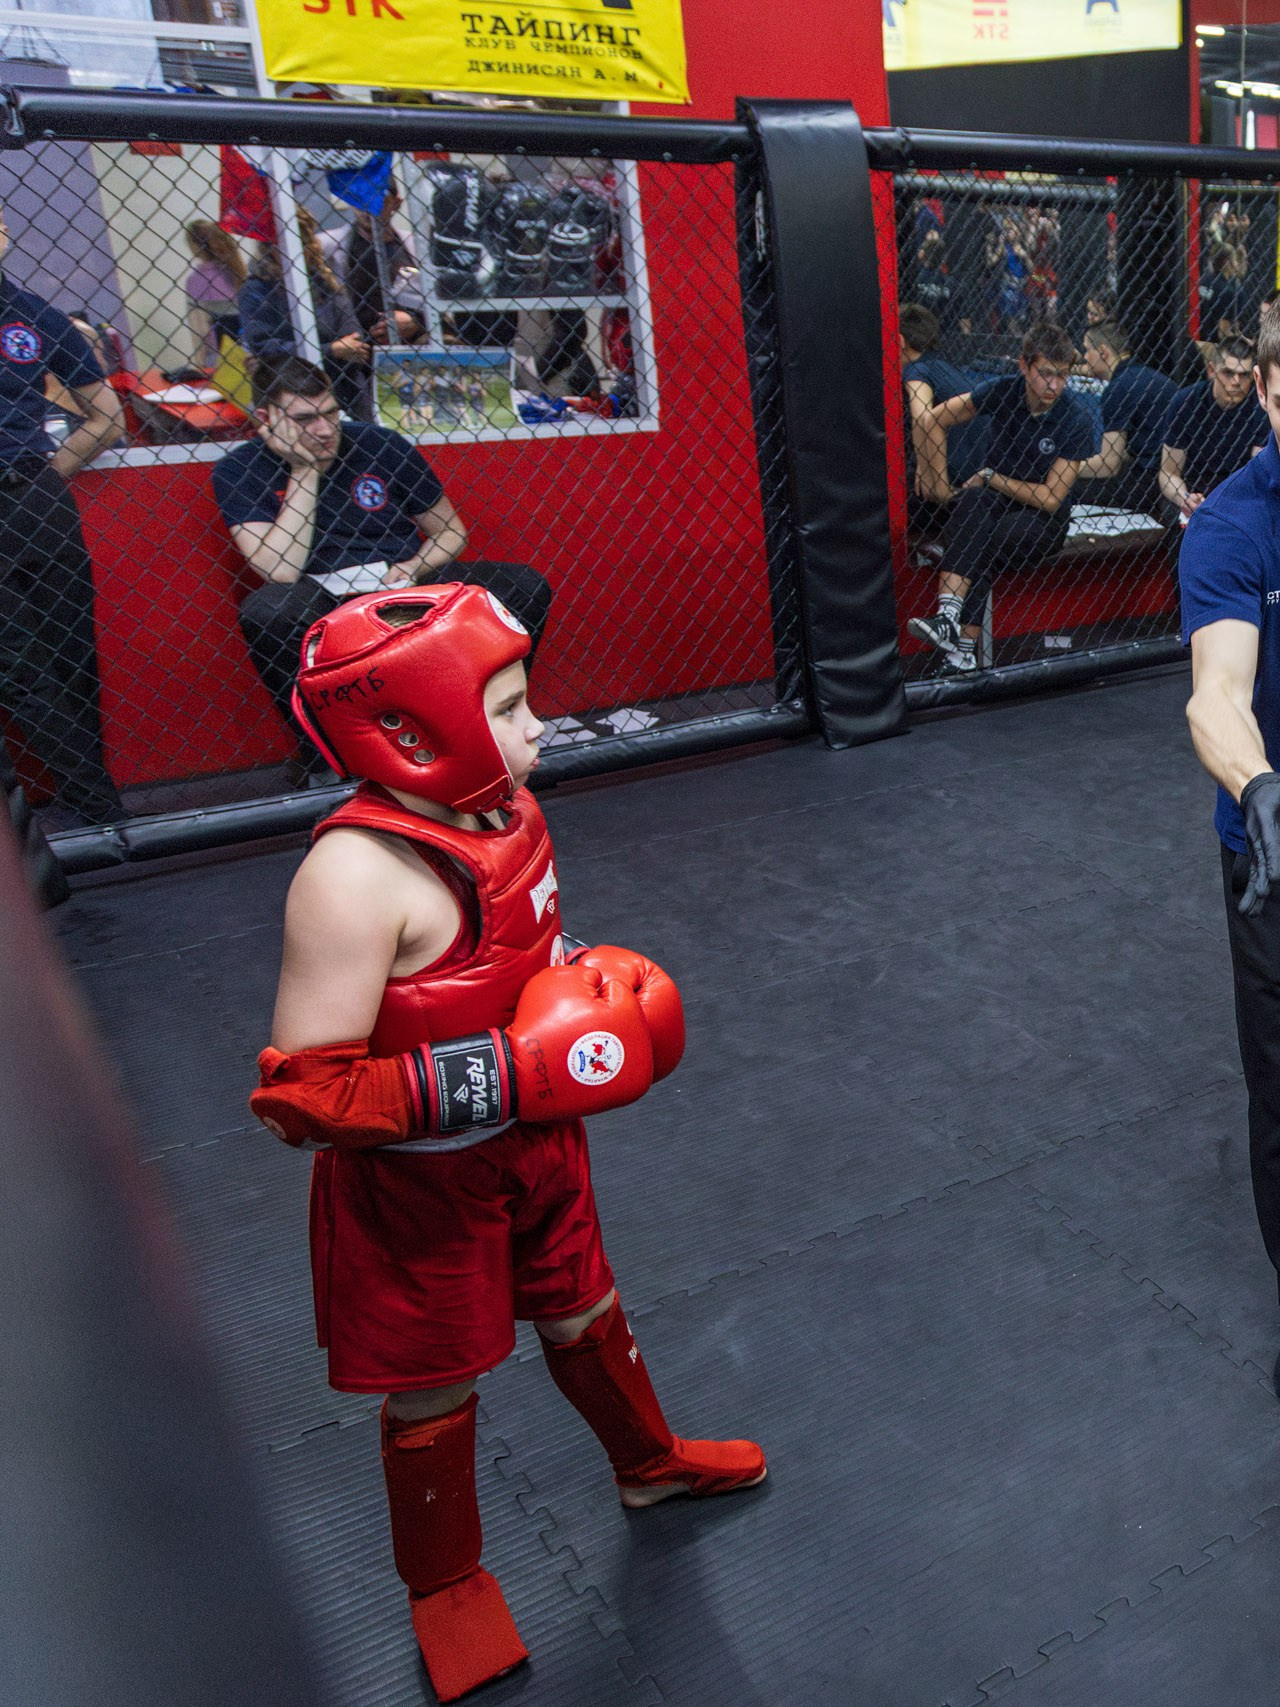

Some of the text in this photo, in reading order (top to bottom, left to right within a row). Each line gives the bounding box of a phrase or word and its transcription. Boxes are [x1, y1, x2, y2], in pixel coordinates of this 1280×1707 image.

[461, 11, 641, 46] ТАЙПИНГ
[464, 36, 643, 60] КЛУБ ЧЕМПИОНОВ
[467, 59, 582, 78] ДЖИНИСЯН
[438, 1061, 448, 1090] BOXING
[466, 1056, 488, 1121] REYVEL
